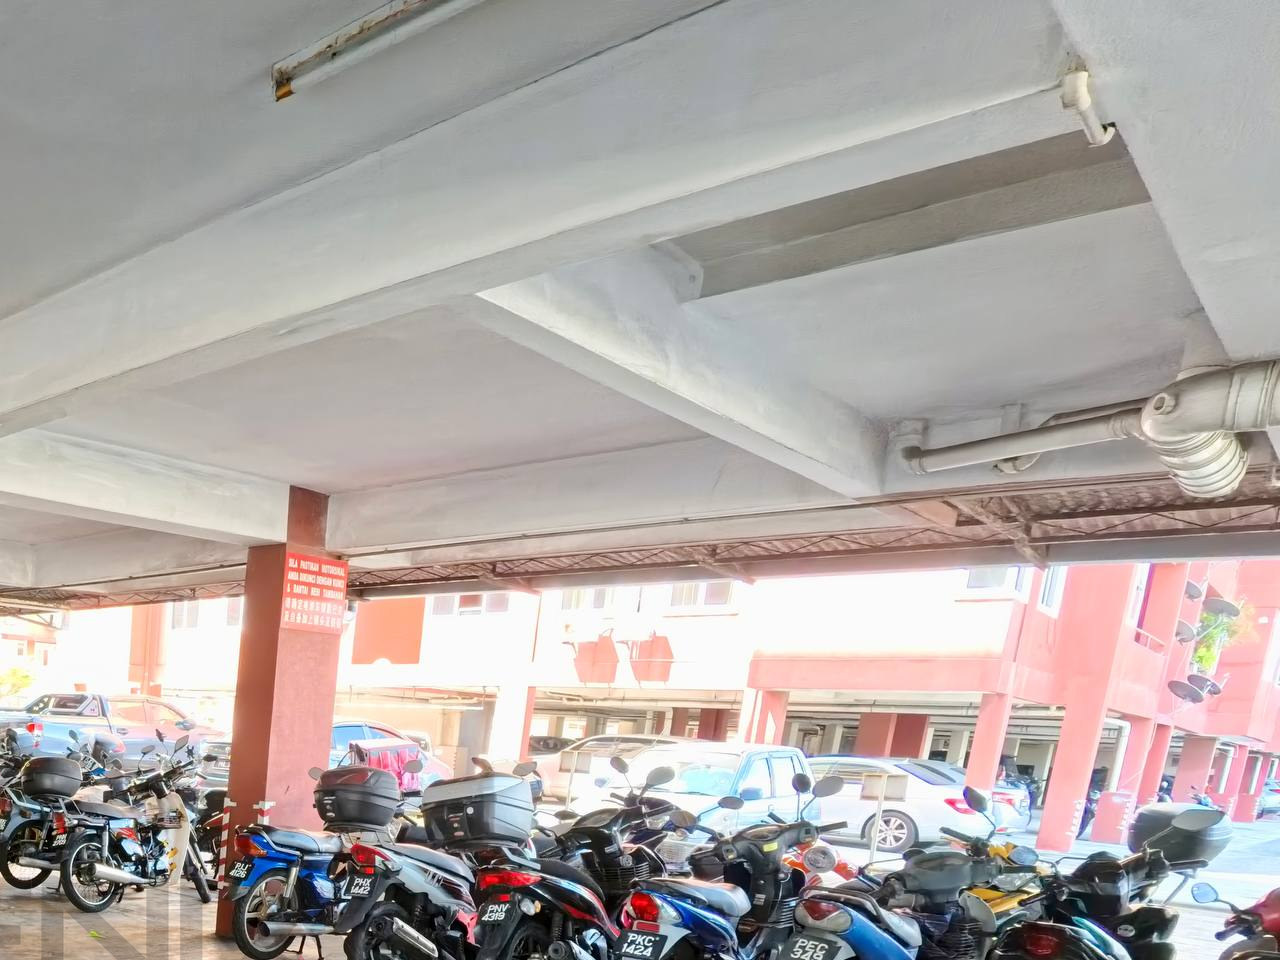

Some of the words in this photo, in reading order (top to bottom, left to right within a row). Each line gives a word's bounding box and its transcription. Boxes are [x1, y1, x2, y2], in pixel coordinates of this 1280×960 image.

[354, 877, 372, 886] PHX
[350, 885, 370, 895] 1442
[487, 904, 509, 914] PNV
[482, 912, 505, 921] 4319
[627, 933, 655, 946] PKC
[621, 942, 652, 956] 1424
[795, 938, 828, 954] PEC
